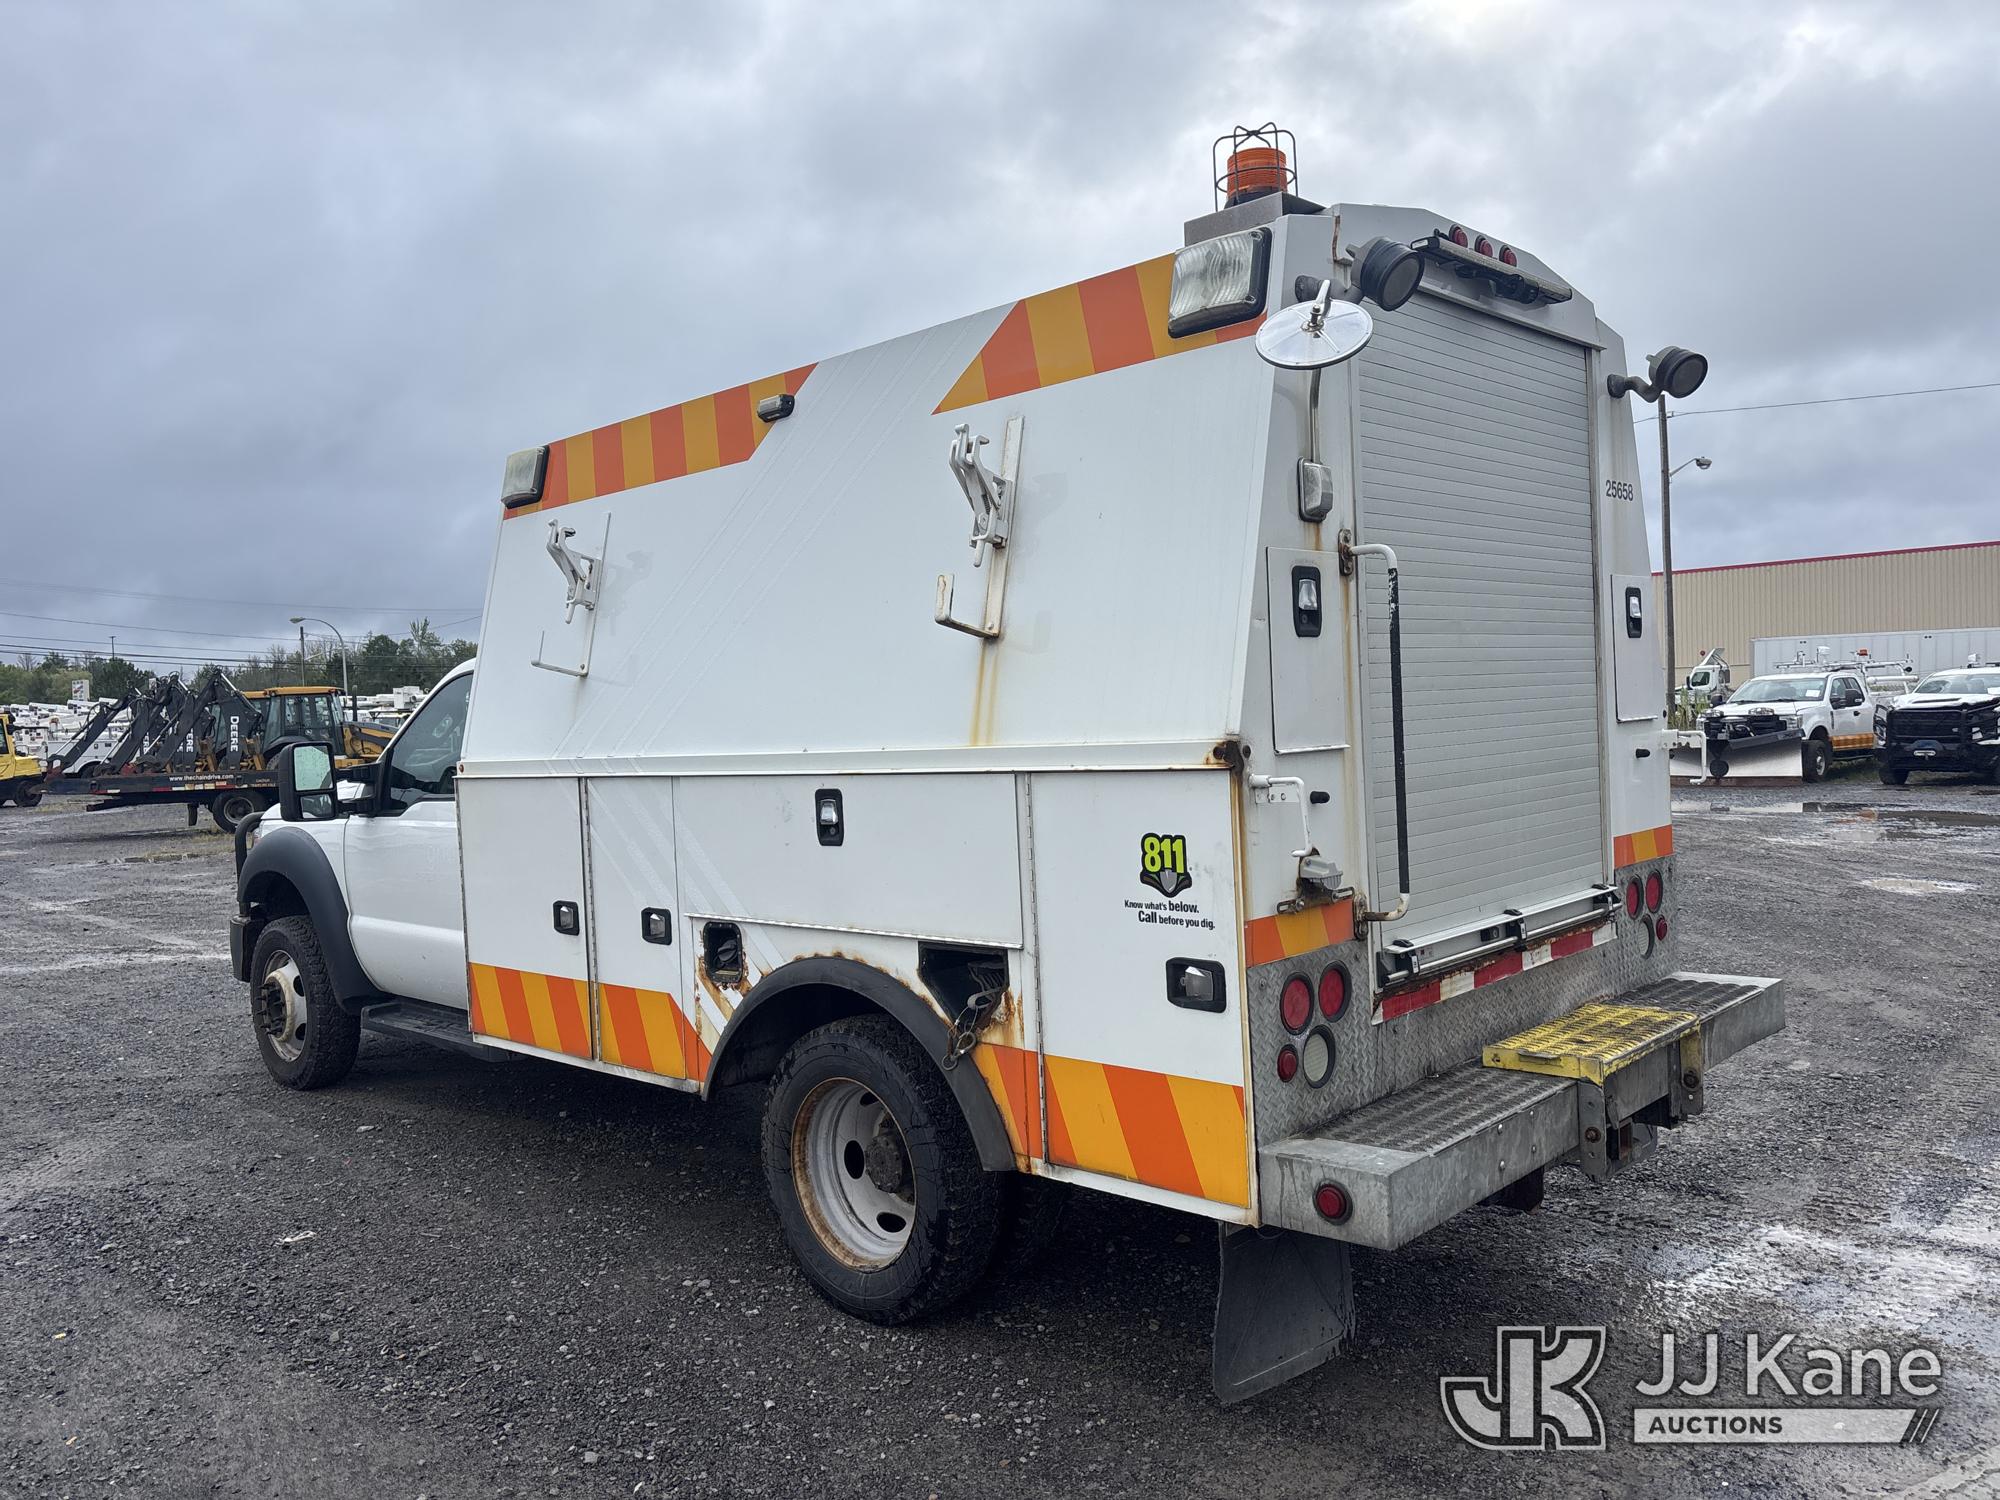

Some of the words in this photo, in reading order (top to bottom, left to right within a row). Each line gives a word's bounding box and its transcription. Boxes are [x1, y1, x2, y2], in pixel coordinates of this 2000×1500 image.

[1605, 479, 1634, 502] 25658
[230, 715, 240, 752] DEERE
[1143, 836, 1185, 874] 811
[1124, 899, 1144, 909] Know
[1144, 902, 1168, 911] what's
[1168, 900, 1200, 914] below.
[1138, 910, 1157, 924] Call
[1159, 914, 1185, 926] before
[1185, 919, 1200, 928] you
[1200, 918, 1216, 931] dig.
